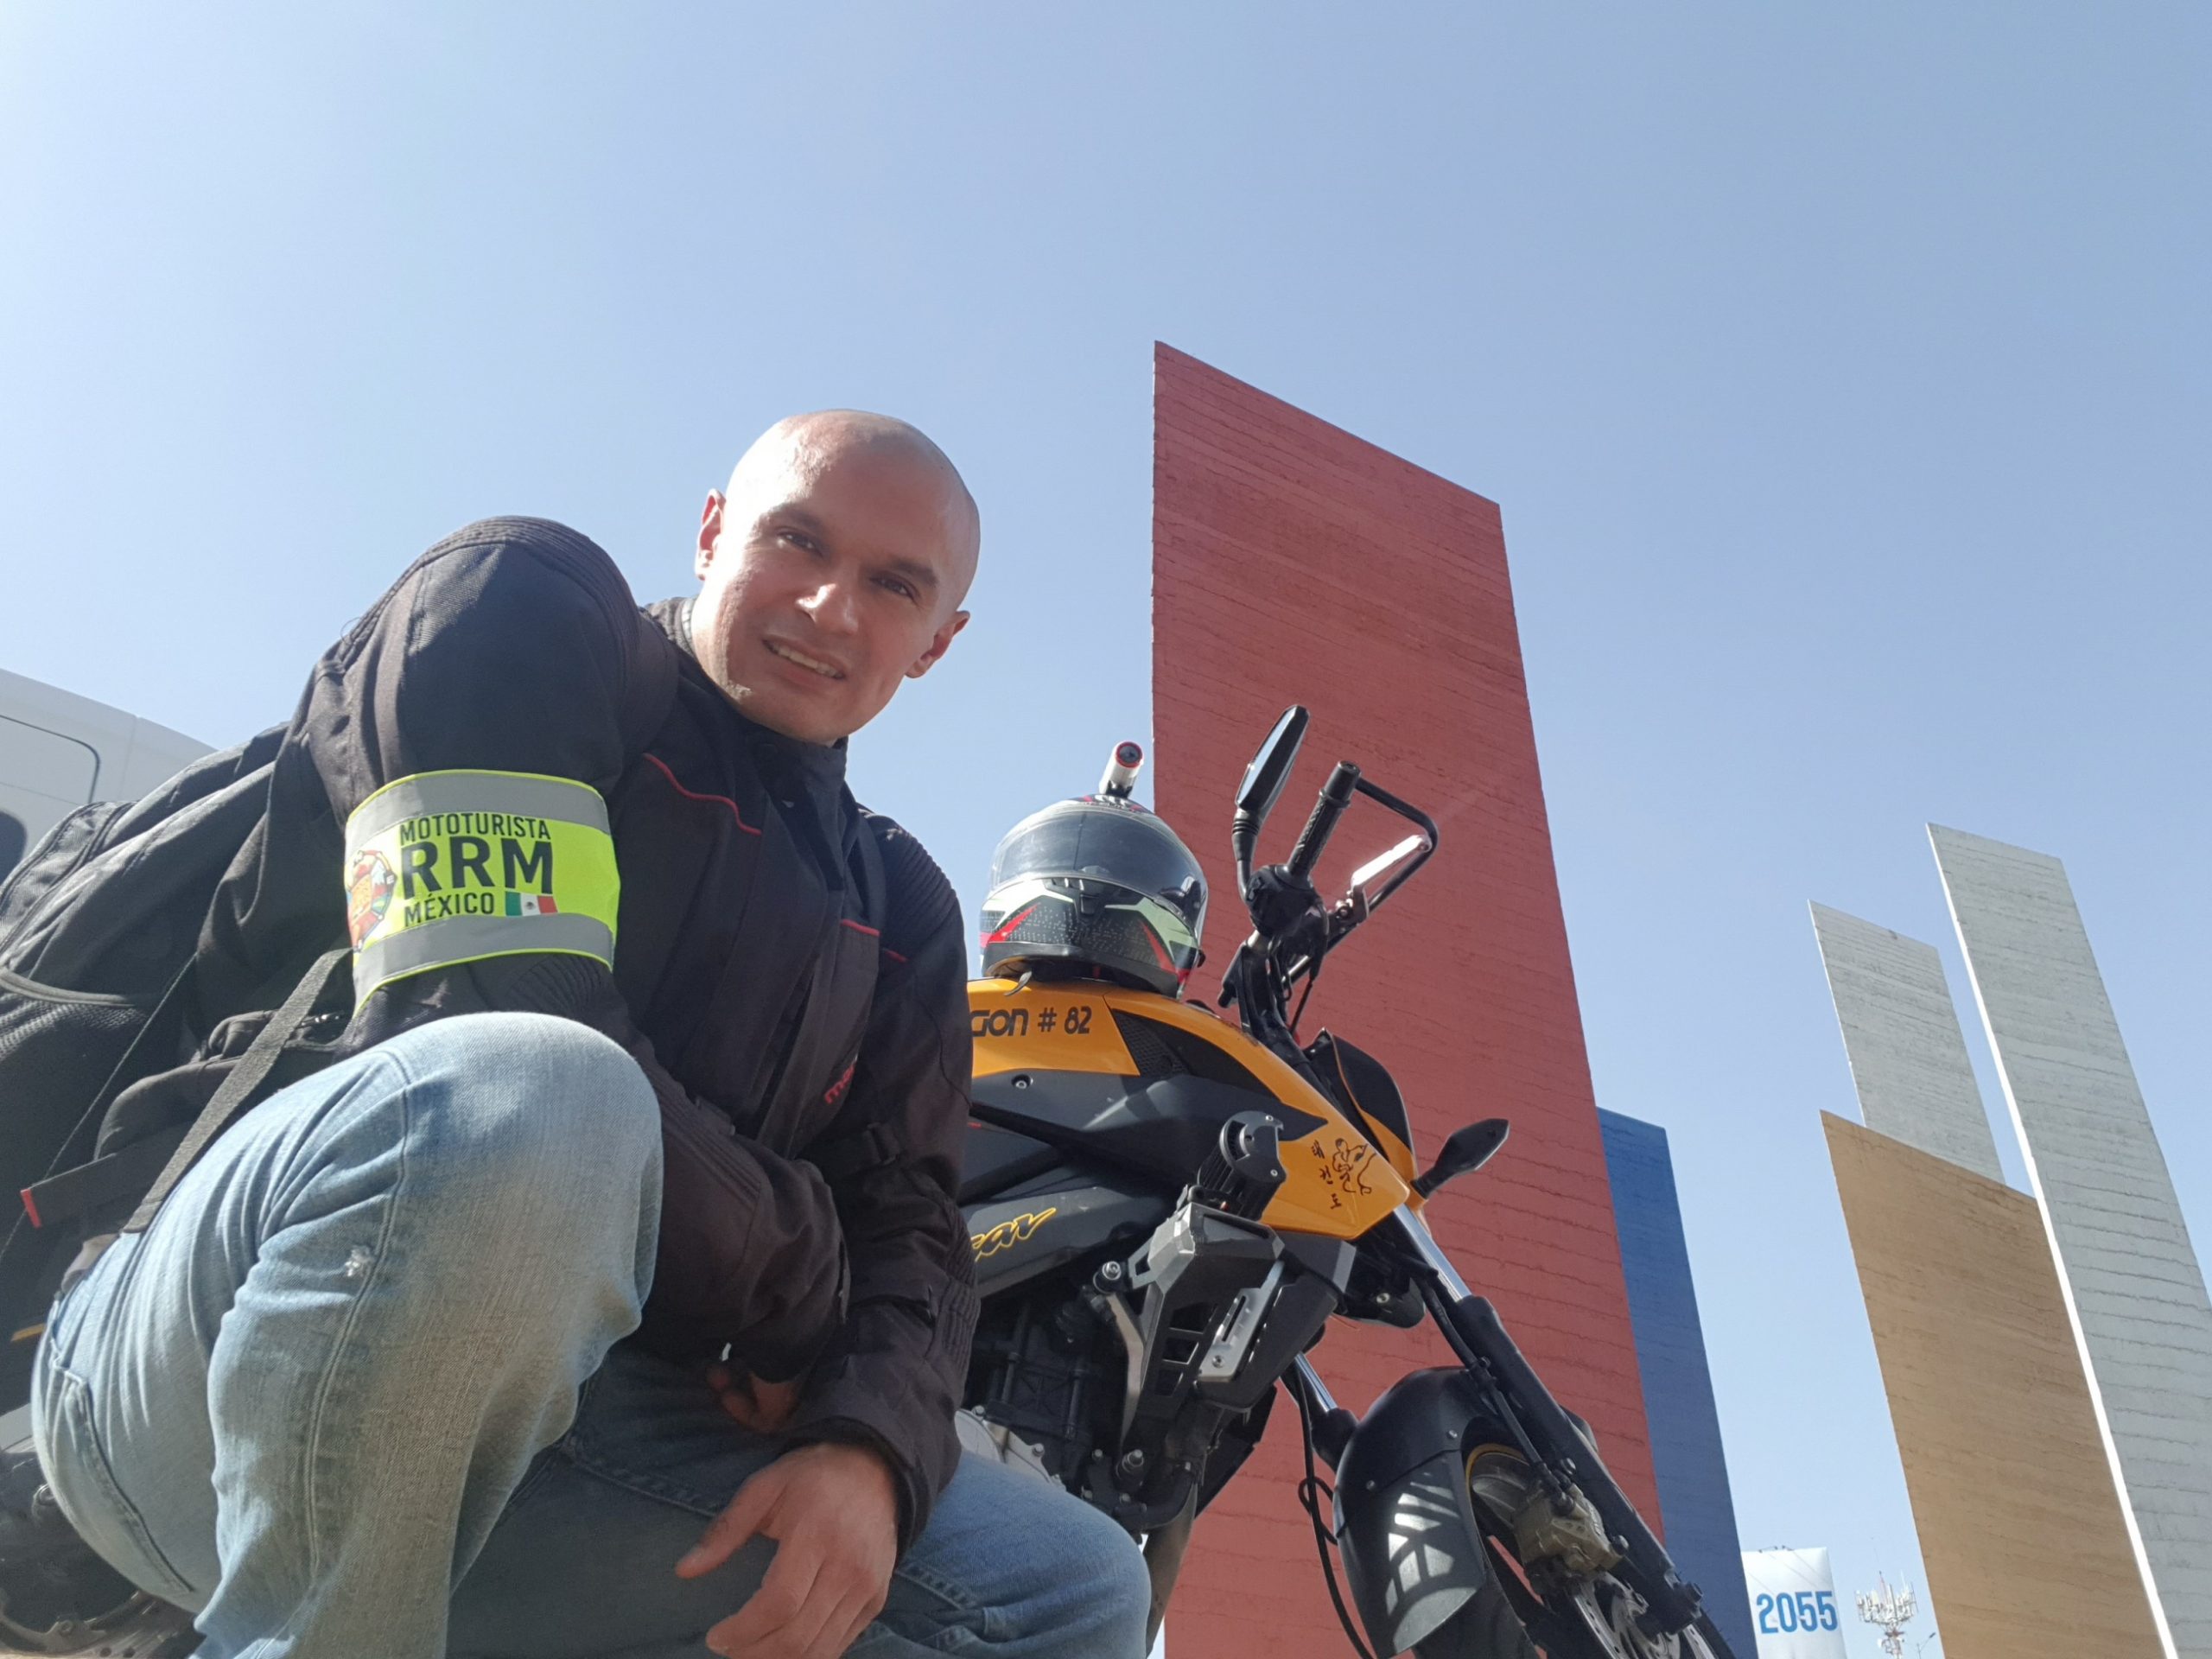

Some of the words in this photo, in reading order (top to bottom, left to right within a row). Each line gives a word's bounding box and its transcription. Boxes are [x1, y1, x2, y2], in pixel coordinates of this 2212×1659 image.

[399, 812, 551, 846] MOTOTURISTA
[401, 836, 553, 900] RRM
[404, 891, 495, 928] MÉXICO
[1064, 1006, 1092, 1035] 82
[1756, 1590, 1838, 1635] 2055
